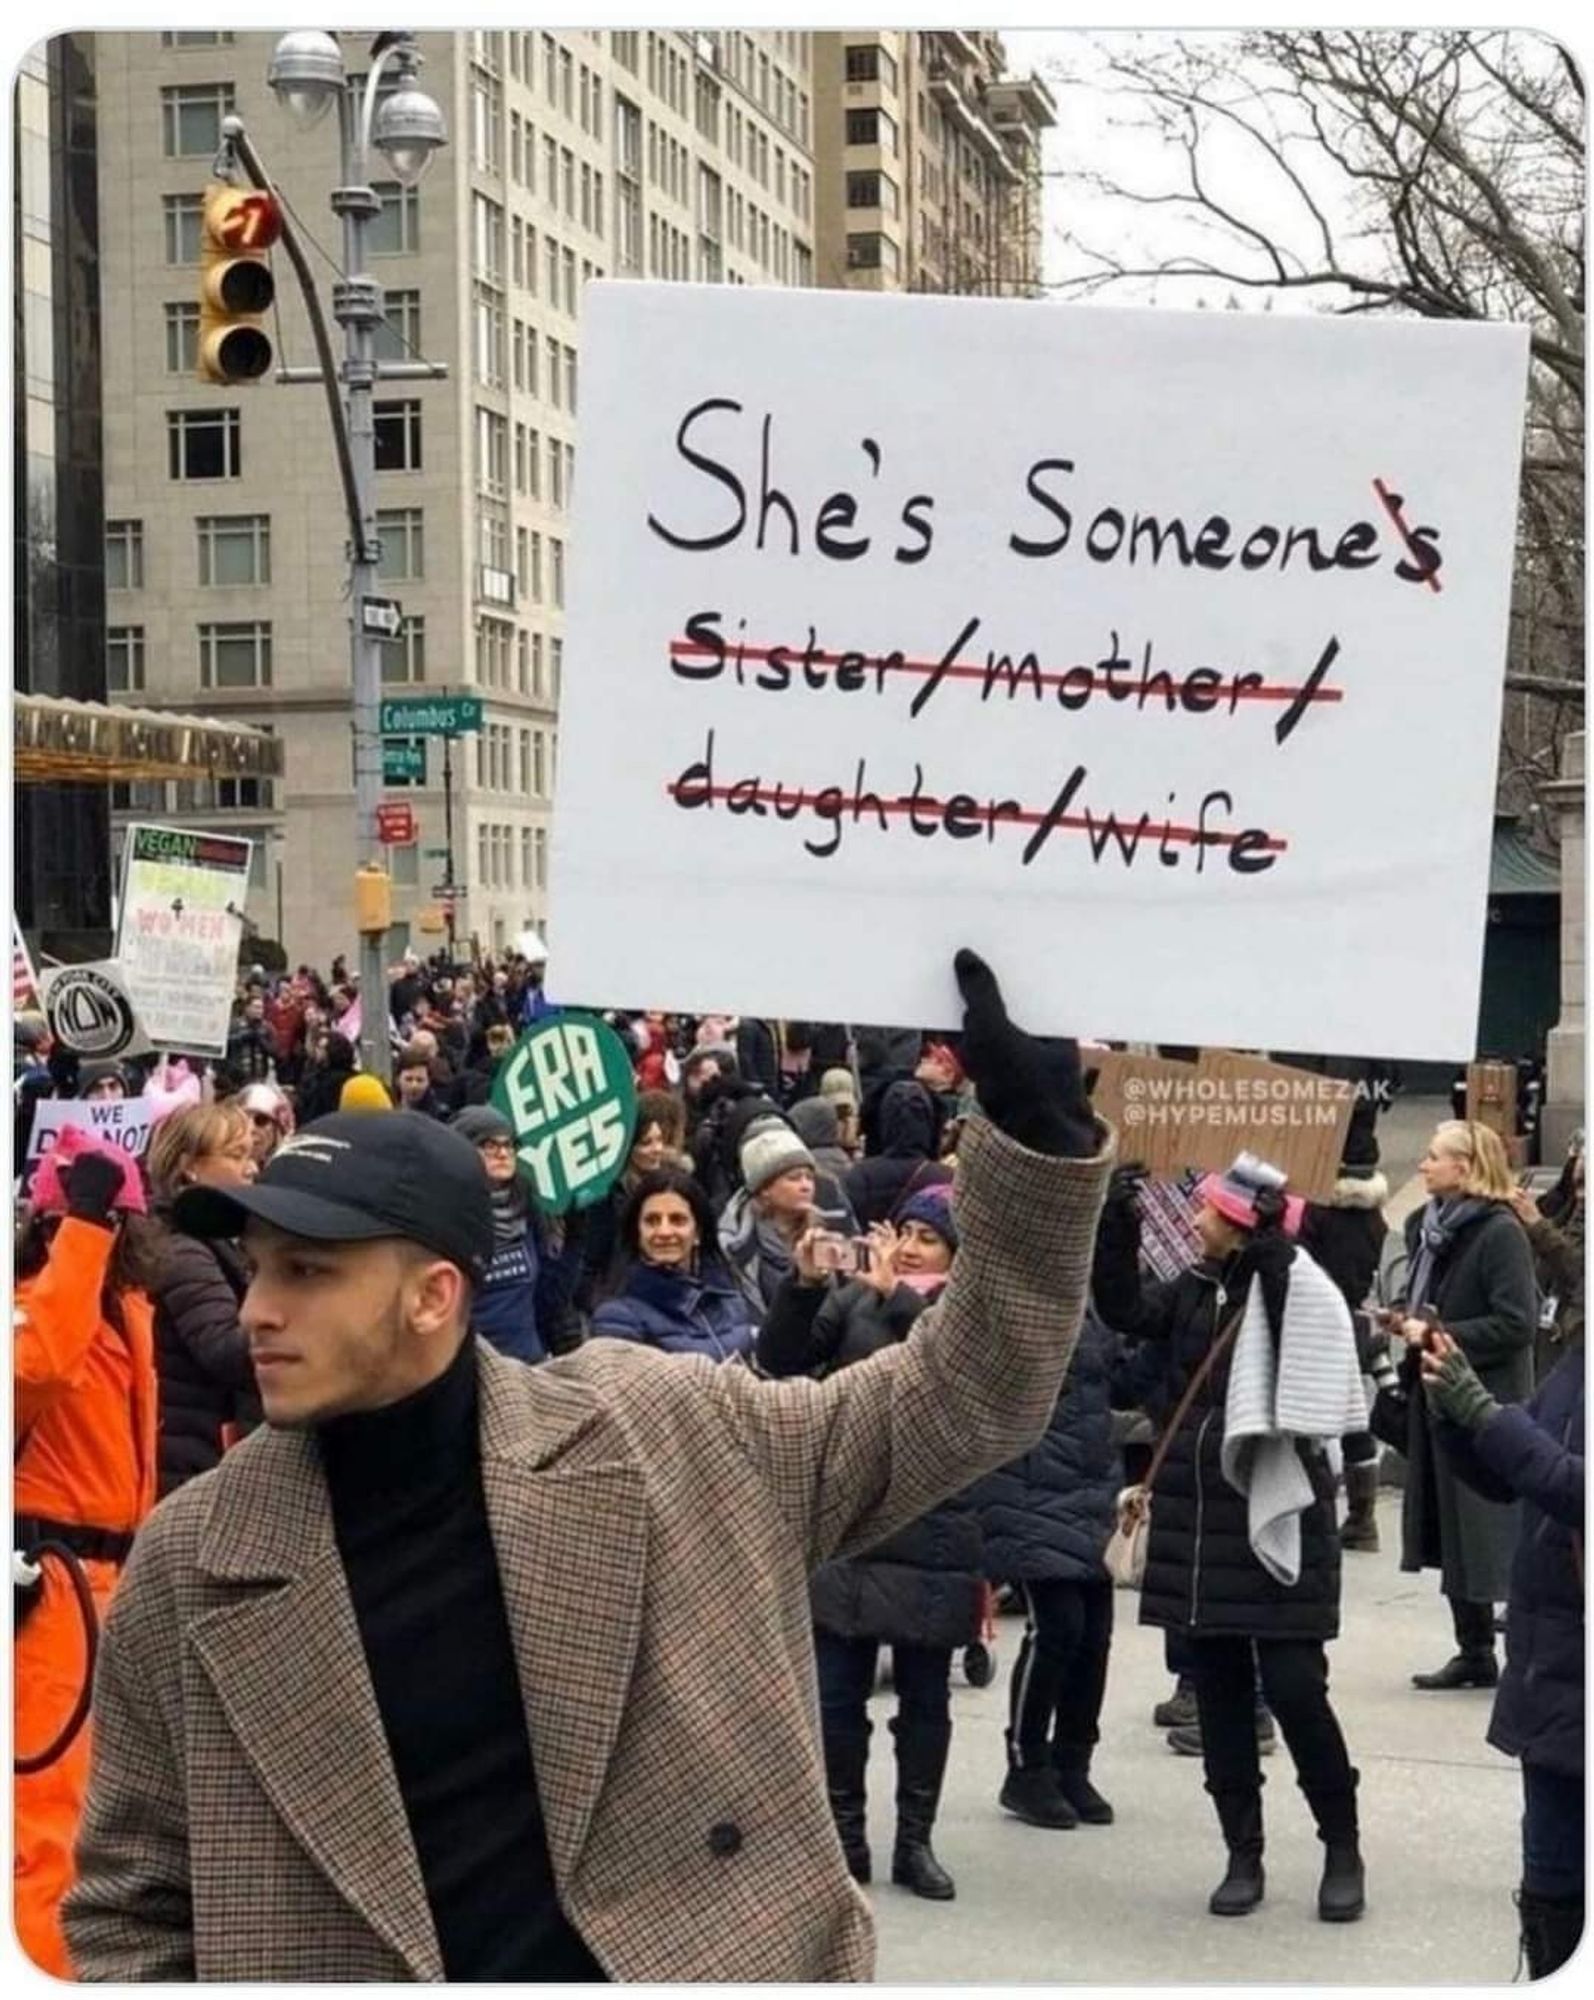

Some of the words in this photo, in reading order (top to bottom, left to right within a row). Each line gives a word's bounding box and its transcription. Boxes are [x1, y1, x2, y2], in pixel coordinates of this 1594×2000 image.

[648, 399, 935, 563] She's
[1009, 458, 1444, 586] Someone's
[383, 704, 456, 731] Columbus
[91, 1104, 124, 1124] WE
[505, 1023, 608, 1136] ERA
[517, 1097, 625, 1200] YES
